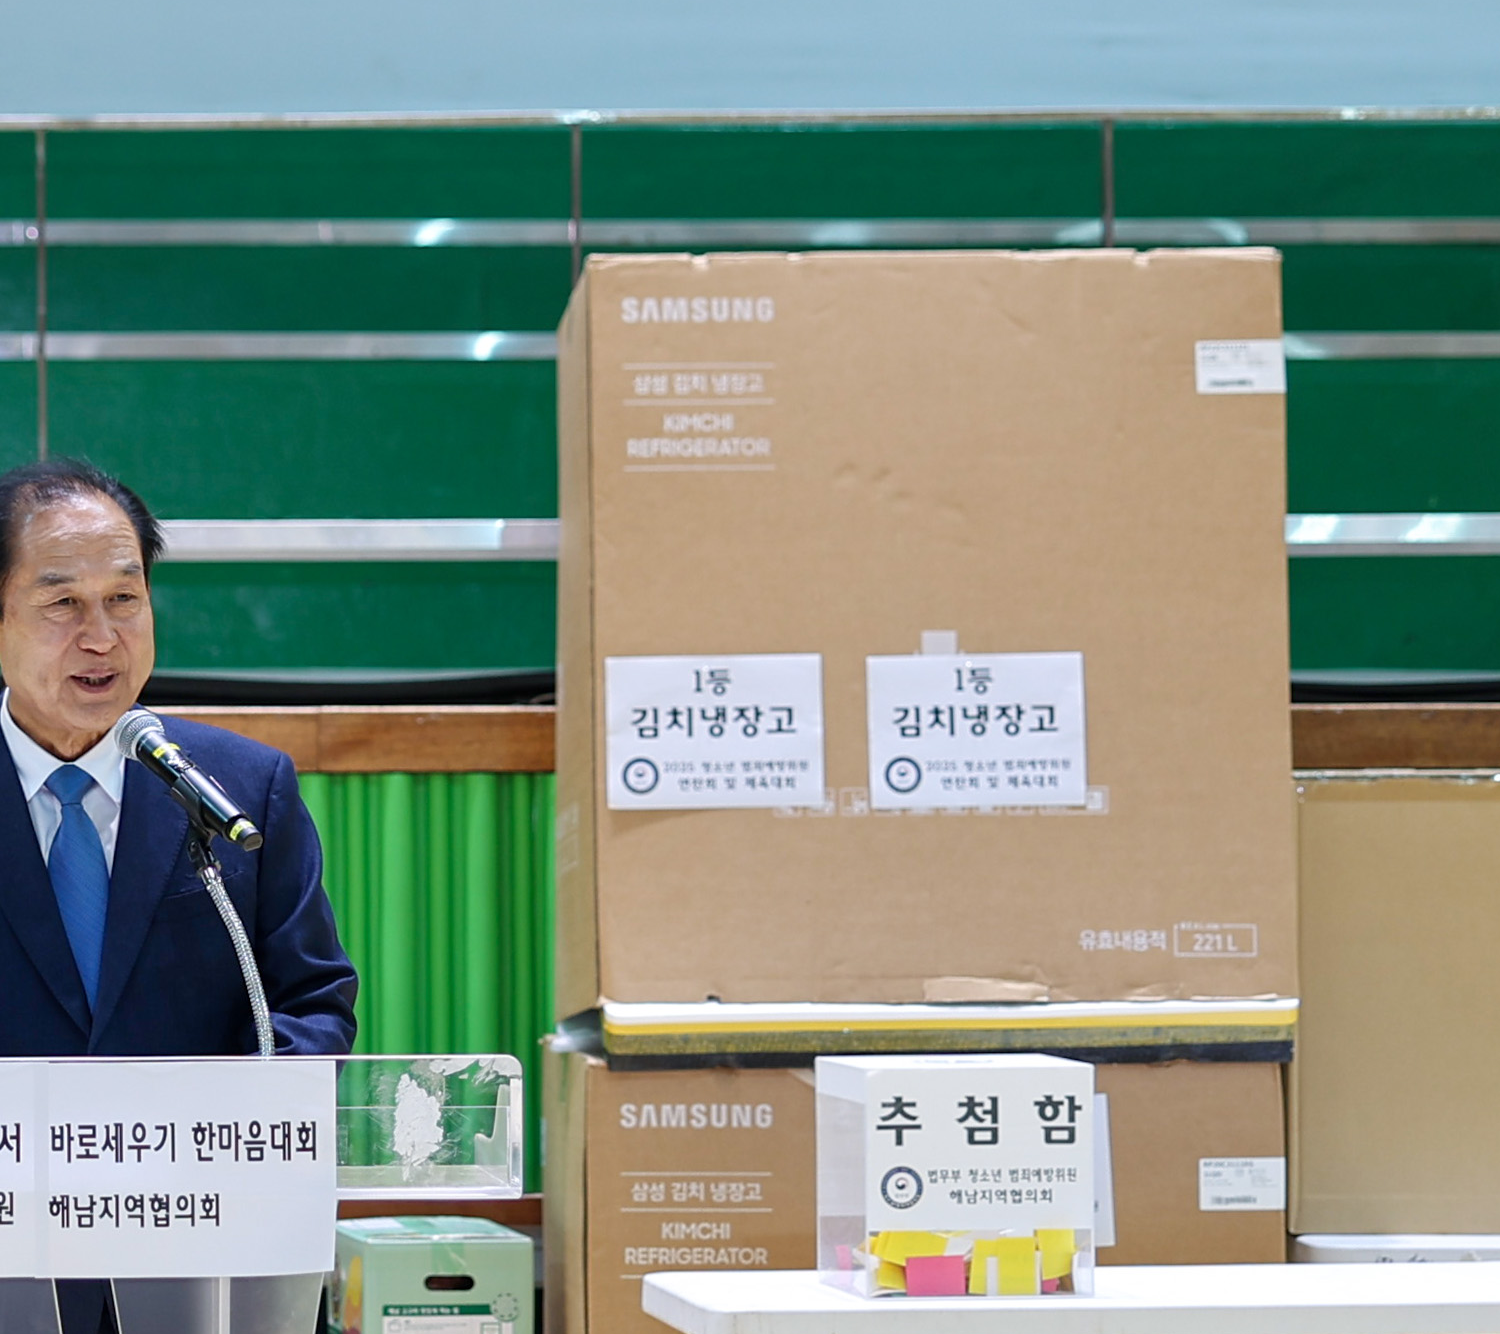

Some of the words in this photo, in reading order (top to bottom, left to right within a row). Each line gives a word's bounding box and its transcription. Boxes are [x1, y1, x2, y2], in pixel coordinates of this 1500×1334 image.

[620, 296, 775, 324] SAMSUNG
[710, 371, 765, 395] 냉장고
[662, 413, 735, 432] KIMCHI
[626, 437, 772, 458] REFRIGERATOR
[693, 668, 731, 696] 1등
[954, 668, 993, 695] 1등
[630, 706, 797, 739] 김치냉장고
[892, 703, 1059, 738] 김치냉장고
[1193, 933, 1223, 951] 221
[1226, 933, 1238, 951] L
[619, 1102, 774, 1129] SAMSUNG
[49, 1121, 177, 1164] 바로세우기
[191, 1119, 318, 1163] 한마음대회
[927, 1168, 962, 1185] 법무부
[967, 1168, 1002, 1184] 청소년
[1008, 1167, 1078, 1183] 범죄예방위원
[630, 1181, 666, 1203] 삼성
[671, 1181, 705, 1202] 김치
[709, 1181, 763, 1203] 냉장고
[948, 1188, 1054, 1205] 해남지역협의회
[48, 1191, 221, 1229] 해남지역협의회
[660, 1222, 731, 1240] KIMCHI
[623, 1246, 768, 1265] REFRIGERATOR
